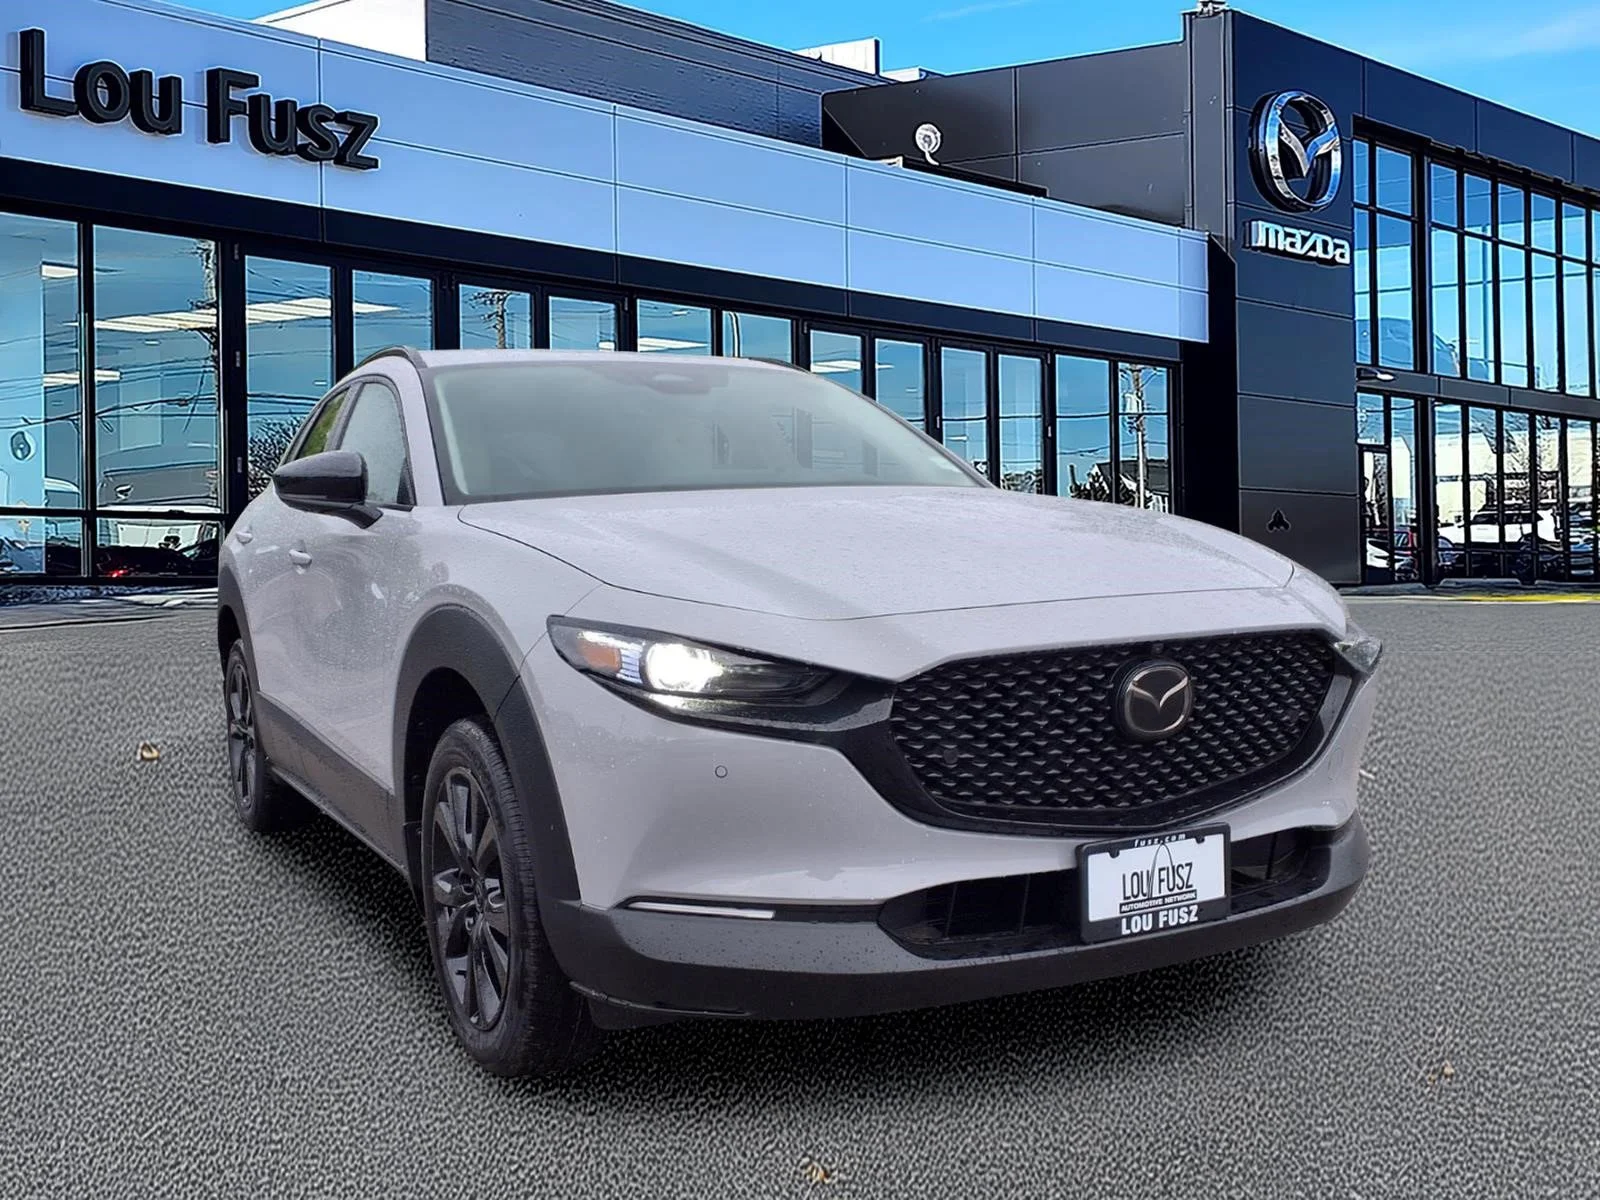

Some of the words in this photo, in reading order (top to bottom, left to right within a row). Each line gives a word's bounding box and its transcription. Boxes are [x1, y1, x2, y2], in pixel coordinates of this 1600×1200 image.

[19, 28, 182, 135] Lou
[206, 67, 380, 170] Fusz
[1122, 869, 1150, 900] LOU
[1158, 862, 1193, 894] FUSZ
[1121, 898, 1163, 912] AUTOMOTIVE
[1164, 891, 1196, 905] NETWORK
[1121, 913, 1152, 935] LOU
[1158, 905, 1198, 928] FUSZ
